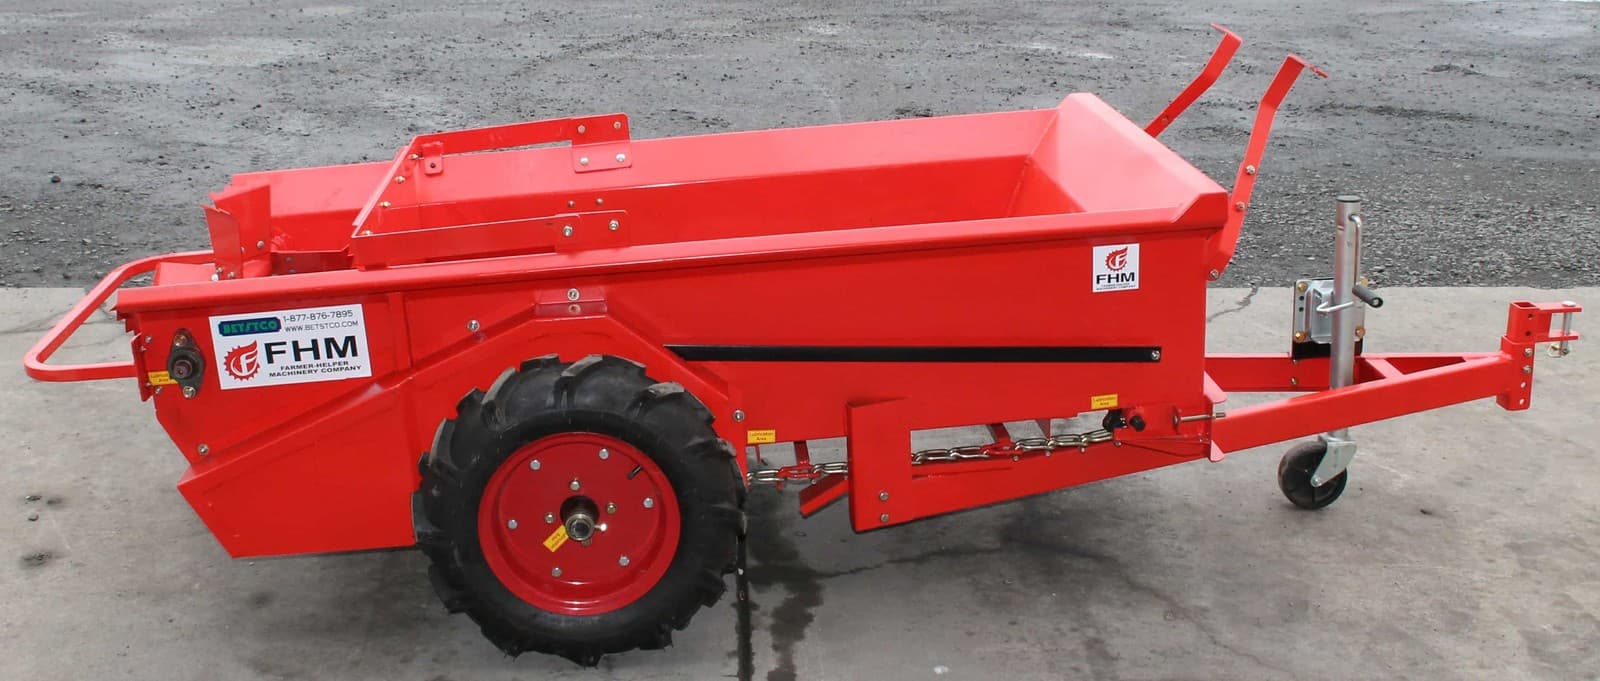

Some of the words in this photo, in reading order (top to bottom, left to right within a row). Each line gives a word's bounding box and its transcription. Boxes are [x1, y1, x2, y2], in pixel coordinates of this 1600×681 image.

[1096, 271, 1135, 285] FHM
[283, 309, 354, 323] 1-877-876-7895
[285, 320, 359, 333] WWW.BETSTCO.COM
[264, 335, 358, 364] FHM
[269, 369, 319, 378] MACHINERY
[321, 365, 362, 374] COMPANY
[280, 360, 349, 371] FARMER-HELPER
